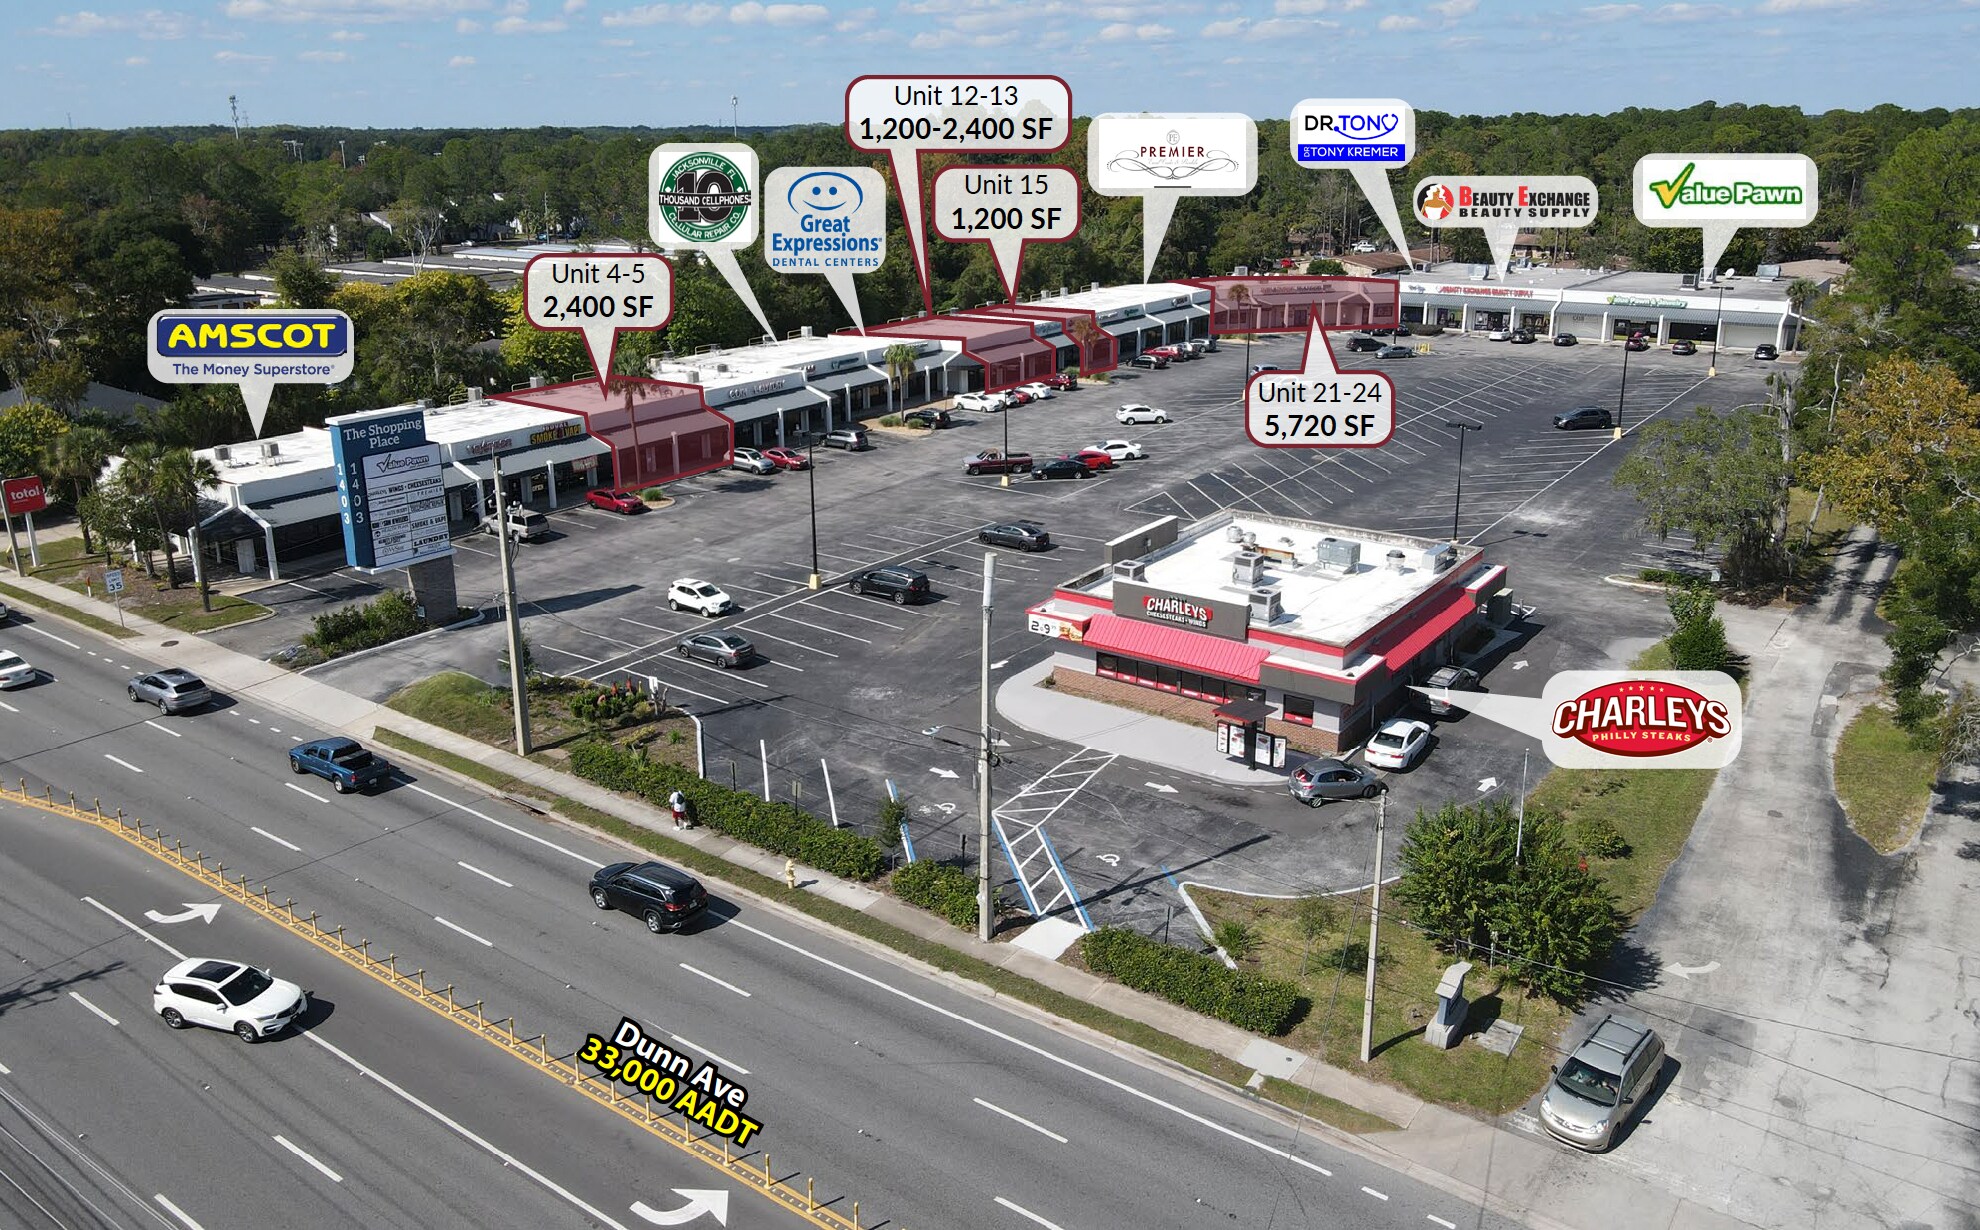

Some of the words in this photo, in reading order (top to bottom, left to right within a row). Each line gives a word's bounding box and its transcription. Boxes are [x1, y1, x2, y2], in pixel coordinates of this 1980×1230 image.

[343, 428, 366, 441] The
[368, 419, 422, 437] Shopping
[530, 430, 558, 445] SMOKE
[369, 435, 400, 449] Place
[376, 453, 405, 473] Value
[405, 455, 430, 467] Pawn
[407, 477, 442, 491] CHEESESTEAKS
[10, 485, 41, 501] total
[413, 533, 449, 547] LAUNDRY
[109, 582, 123, 592] 35
[1146, 597, 1208, 621] CHARLEYS
